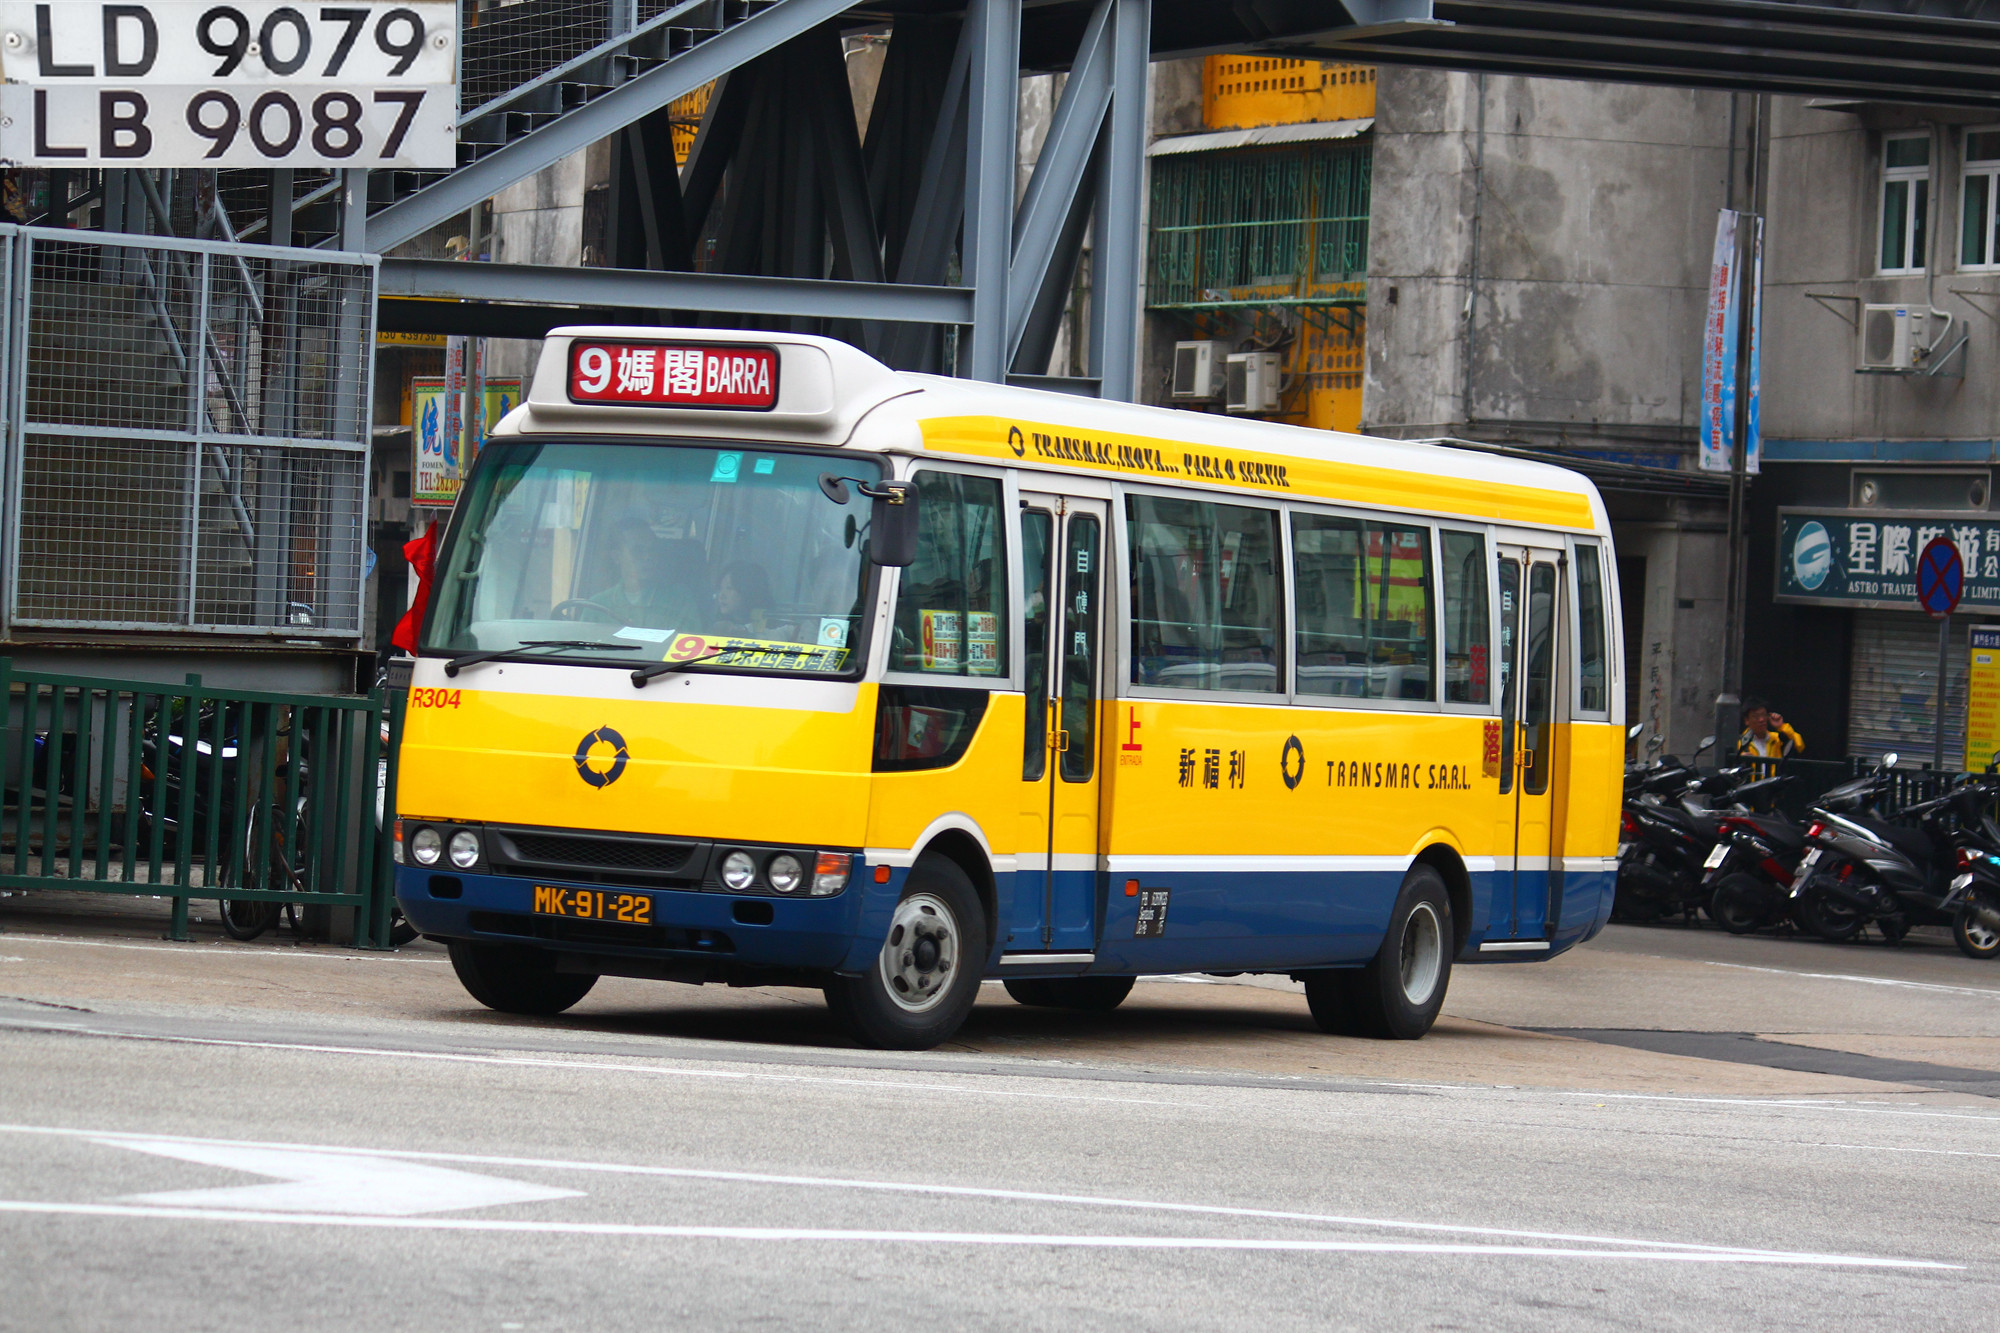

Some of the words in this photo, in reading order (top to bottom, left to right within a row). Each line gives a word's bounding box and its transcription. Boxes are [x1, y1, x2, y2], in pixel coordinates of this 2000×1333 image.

[579, 347, 612, 394] 9
[616, 348, 703, 396] 媽閣
[706, 356, 771, 395] BARRA
[422, 461, 444, 469] FOMEN
[1184, 453, 1224, 480] PARA
[1225, 458, 1236, 481] O
[1848, 580, 1879, 594] ASTRO
[1882, 582, 1918, 596] TRAVEL
[670, 636, 706, 661] 9
[411, 687, 462, 710] R304
[1122, 706, 1142, 751] 上
[1484, 721, 1500, 764] 落
[1177, 747, 1246, 790] 新福利
[1326, 760, 1421, 789] TRANSMAC
[1428, 764, 1471, 791] S.A.R.L.
[534, 885, 651, 925] MK-91-22
